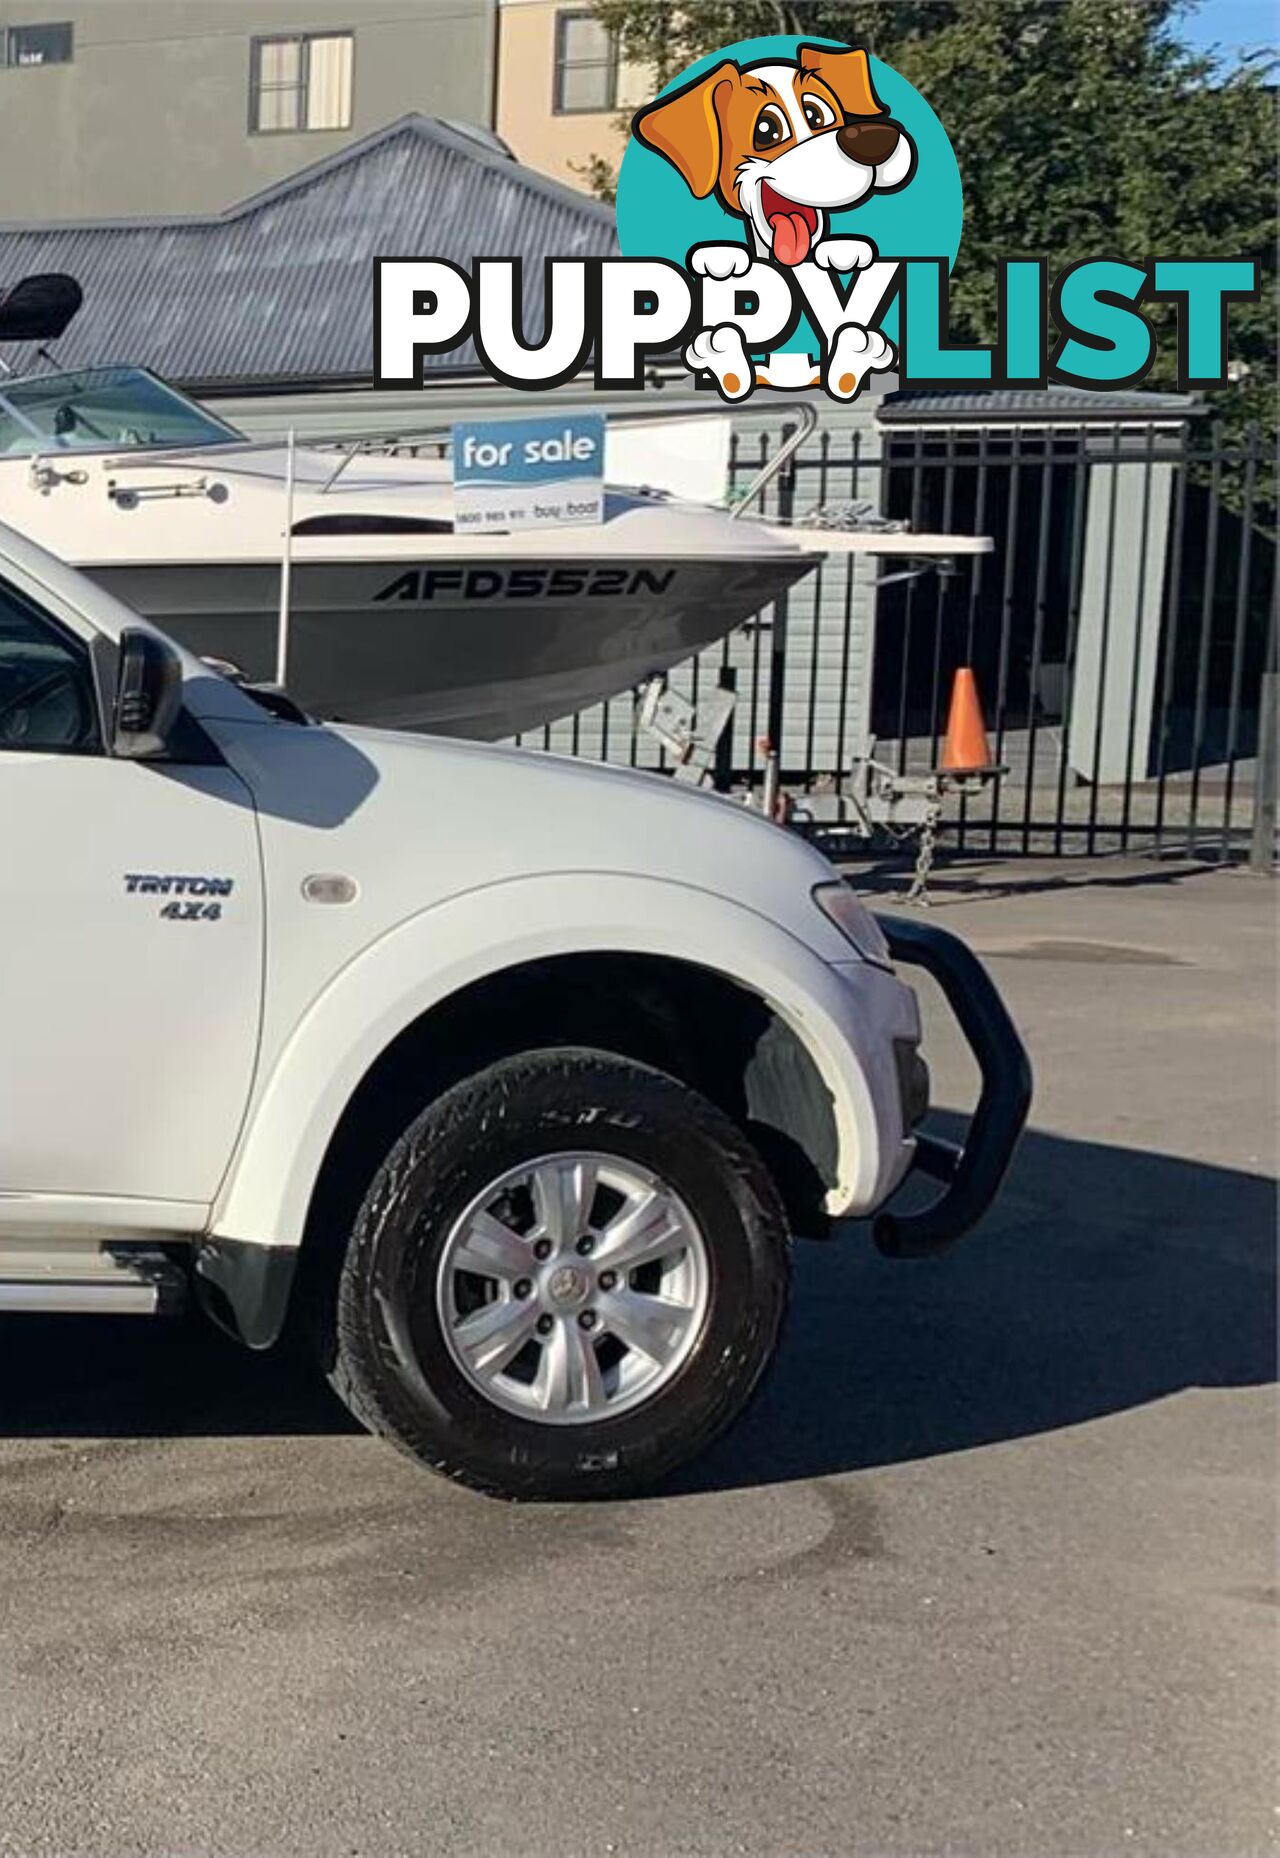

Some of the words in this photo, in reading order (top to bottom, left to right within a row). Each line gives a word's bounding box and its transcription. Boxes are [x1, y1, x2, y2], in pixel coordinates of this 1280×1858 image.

[463, 436, 513, 469] for
[524, 428, 596, 464] sale
[371, 568, 677, 601] AFD552N
[124, 874, 234, 897] TRITON
